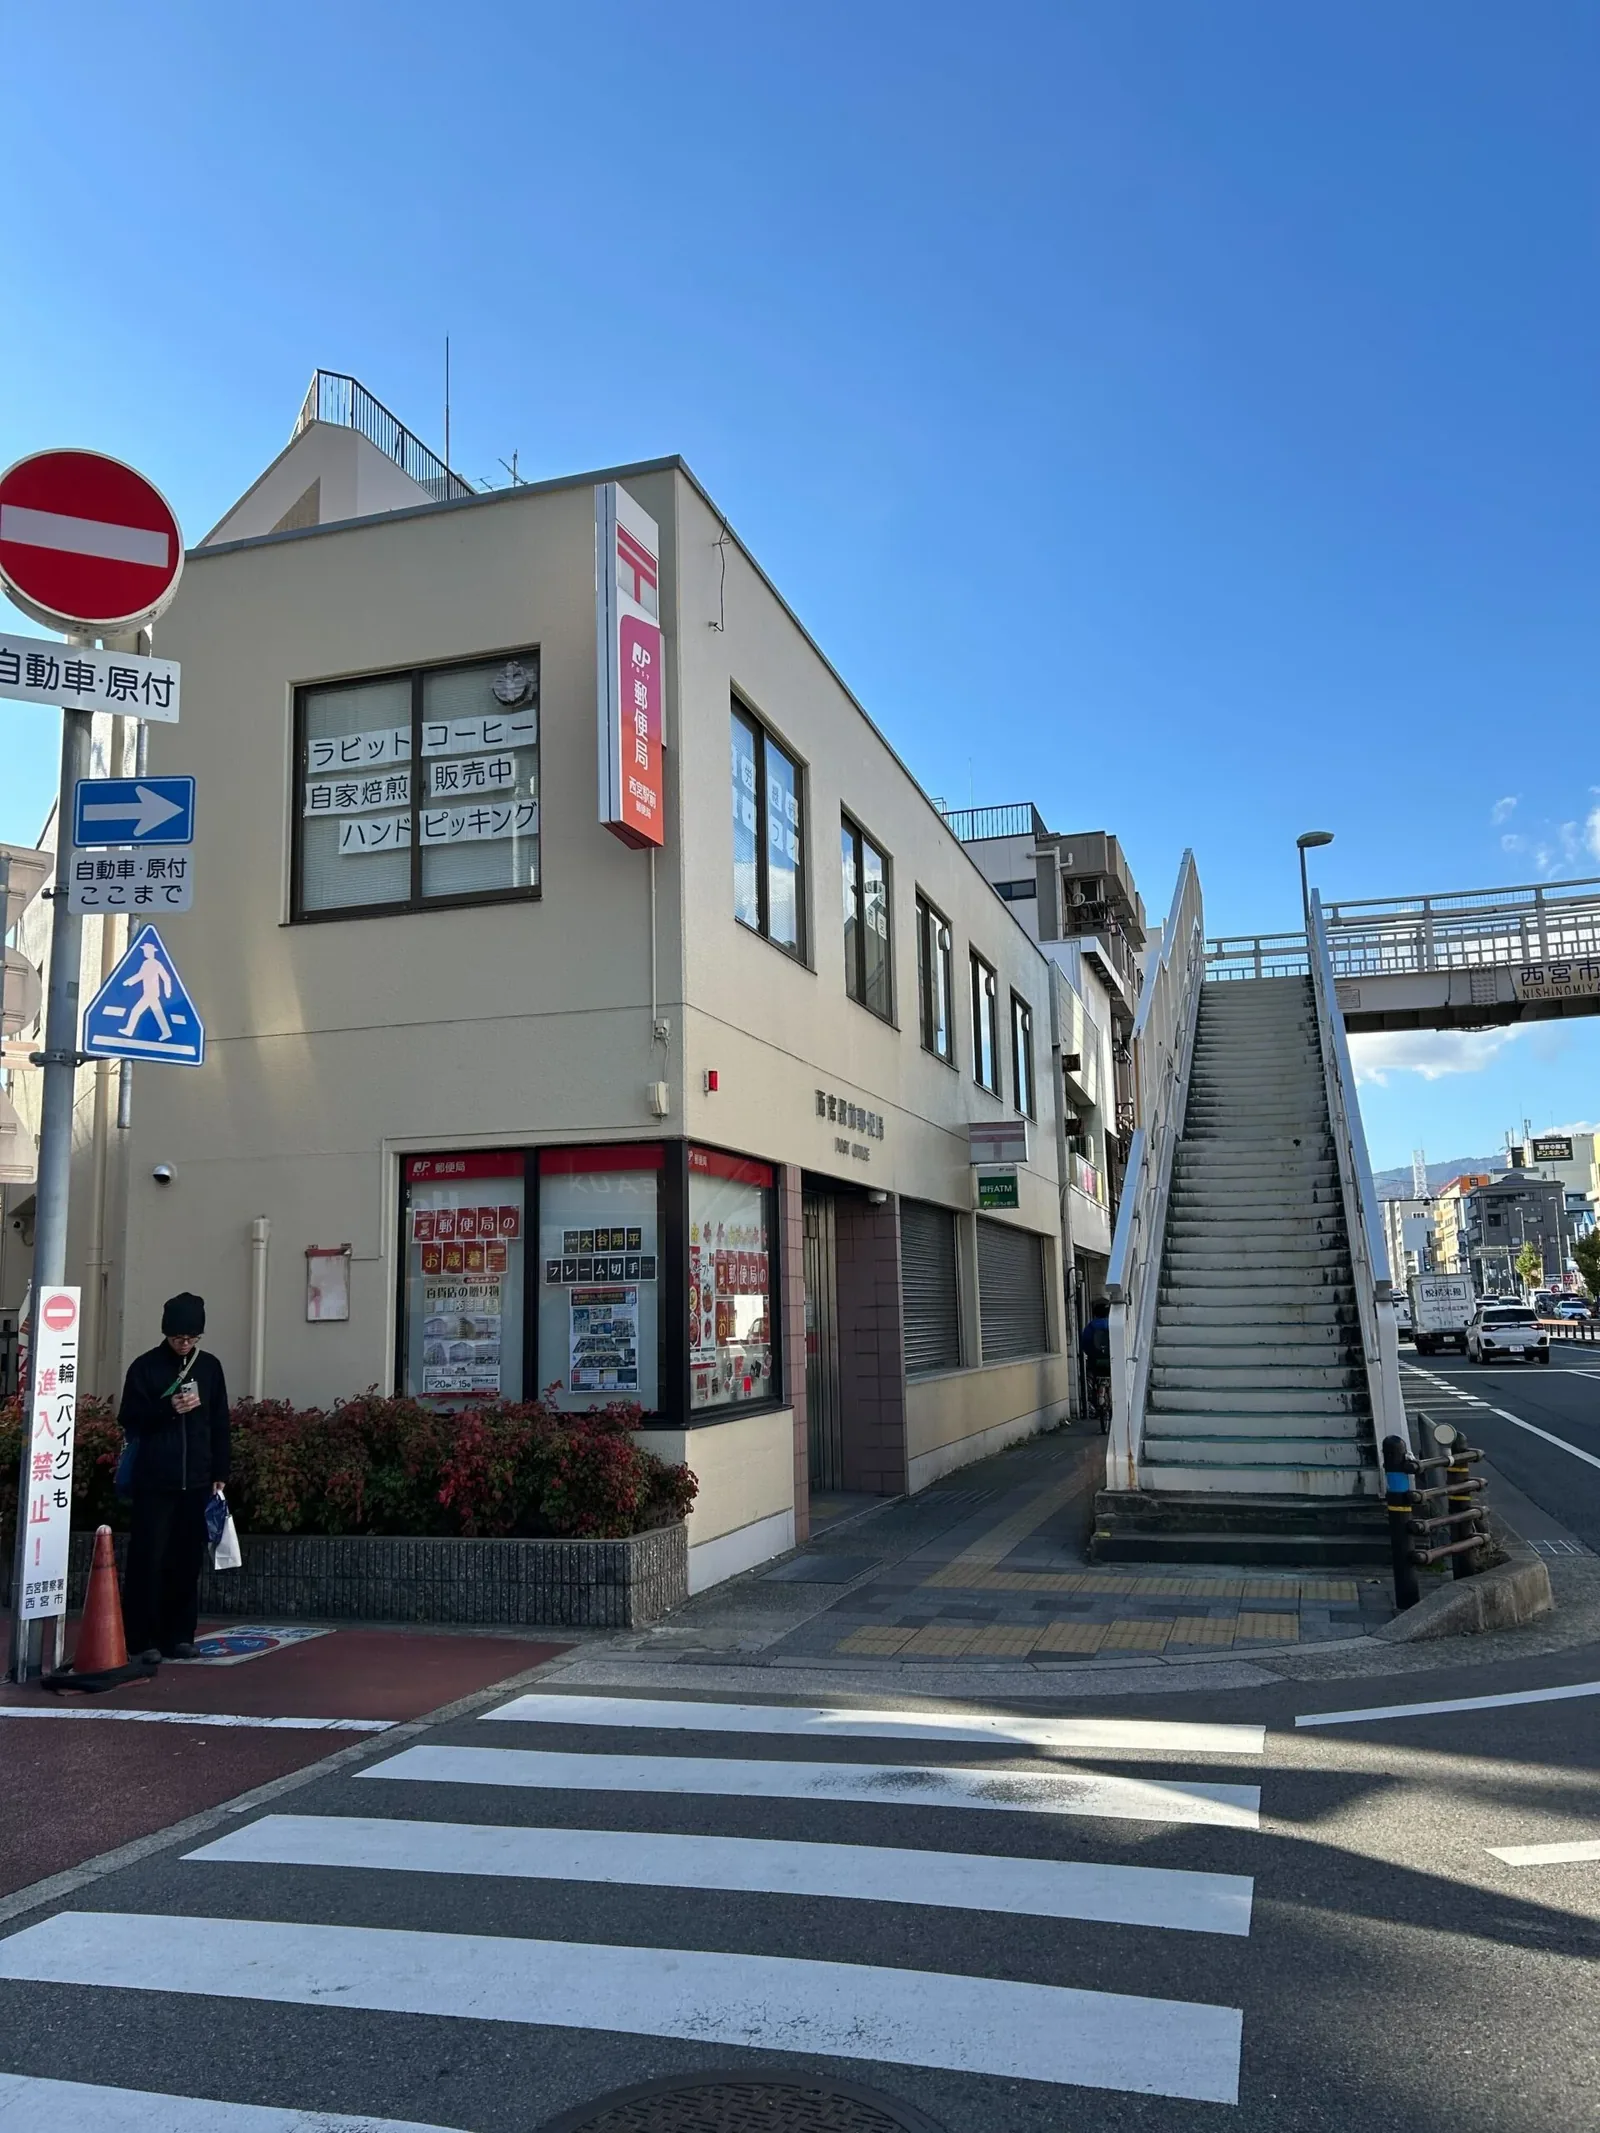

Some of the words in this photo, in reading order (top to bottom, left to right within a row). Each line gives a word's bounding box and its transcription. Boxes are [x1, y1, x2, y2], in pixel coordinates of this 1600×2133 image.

[633, 679, 649, 770] 郵便局
[312, 731, 411, 767] ラビット
[427, 720, 534, 747] コーヒー
[310, 775, 409, 810] 自家焙煎
[434, 758, 512, 791] 販売中
[628, 775, 657, 810] 西宮駅前
[342, 818, 412, 847] ハンド
[424, 801, 538, 838] ピッキング
[80, 884, 183, 906] ここまで
[1519, 960, 1600, 987] 西宮市
[434, 1161, 466, 1174] 郵便局
[438, 1216, 516, 1234] 郵便局の
[581, 1233, 640, 1248] 大谷翔平
[425, 1250, 482, 1269] お歳暮
[549, 1261, 639, 1277] フレーム切手
[728, 1264, 767, 1286] 郵便局の
[426, 1285, 500, 1299] 百貨店の贈り物
[25, 1577, 65, 1596] 西宮警察署
[24, 1593, 64, 1610] 西宮市
